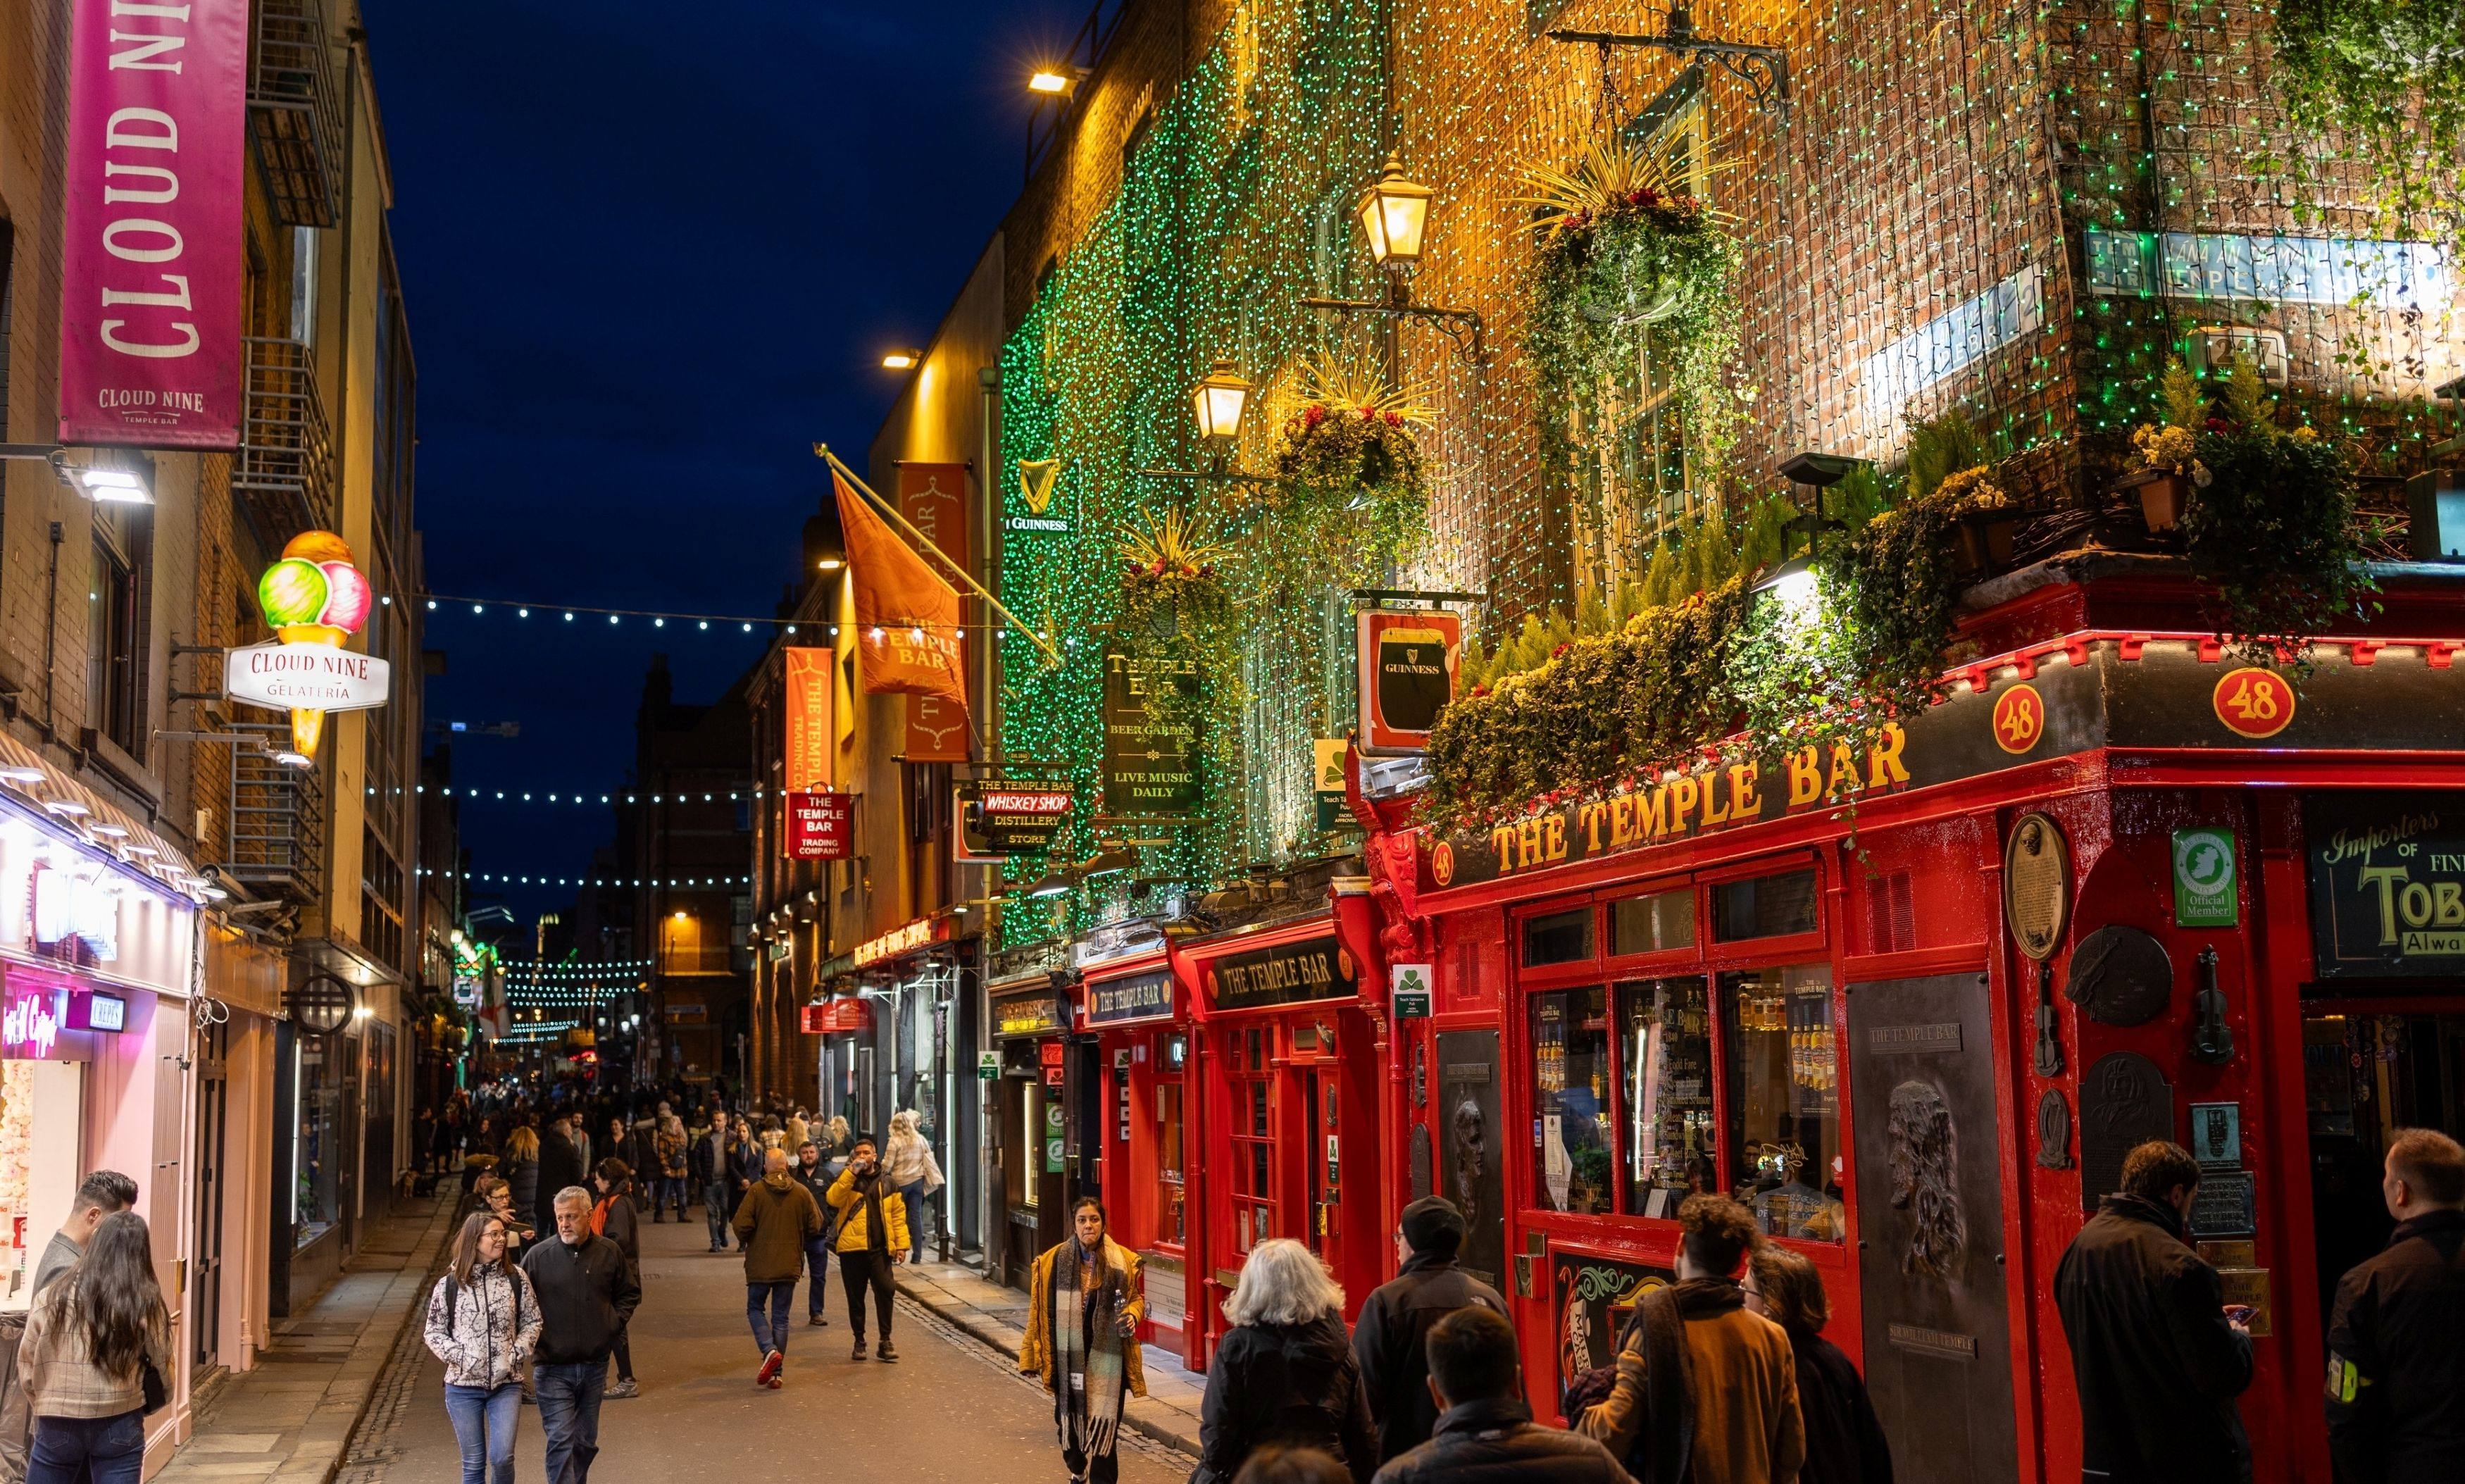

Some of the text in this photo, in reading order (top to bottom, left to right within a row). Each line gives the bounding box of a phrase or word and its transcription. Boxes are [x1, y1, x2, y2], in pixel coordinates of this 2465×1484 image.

[100, 107, 200, 358] CLOUD
[2022, 284, 2035, 317] 2
[99, 389, 204, 413] CLOUD NINE
[1011, 517, 1068, 531] GUINNESS
[872, 631, 959, 659] TEMPLE
[251, 652, 369, 680] CLOUD NINE
[898, 649, 946, 671] BAR
[1385, 663, 1440, 675] GUINNESS
[267, 685, 350, 699] GELATERIA
[807, 678, 822, 714] THE
[2227, 678, 2278, 721] 48
[2001, 699, 2034, 742] 48
[1110, 725, 1143, 735] BEER
[794, 716, 804, 772] TRADING
[978, 780, 1075, 792] THE TEMPLE BAR
[1115, 773, 1193, 783] LIVE MUSIC
[1132, 787, 1175, 797] DAILY
[1492, 722, 1911, 873] THE TEMPLE BAR
[809, 797, 832, 807] THE
[987, 795, 1068, 811] WHISKEY SHOP
[796, 809, 844, 820] TEMPLE
[994, 816, 1061, 825] DISTILLERY
[806, 821, 833, 833] BAR
[801, 838, 838, 847] TRADING
[1009, 835, 1047, 844] STORE
[2322, 810, 2439, 866] Importers
[799, 847, 840, 855] COMPANY
[2397, 843, 2419, 857] OF
[1435, 849, 1449, 878] 48
[2190, 894, 2225, 906] Official
[2187, 906, 2229, 916] Member
[1224, 952, 1332, 994] THE TEMPLE BAR
[1099, 984, 1159, 1012] THE TEMPLE BAR
[1795, 985, 1816, 995] TEMPLE
[94, 1002, 120, 1025] CREPES
[1870, 1025, 1959, 1043] THE TEMPLE BAR
[1889, 1325, 1902, 1338] SIR
[1939, 1333, 1973, 1350] TEMPLE
